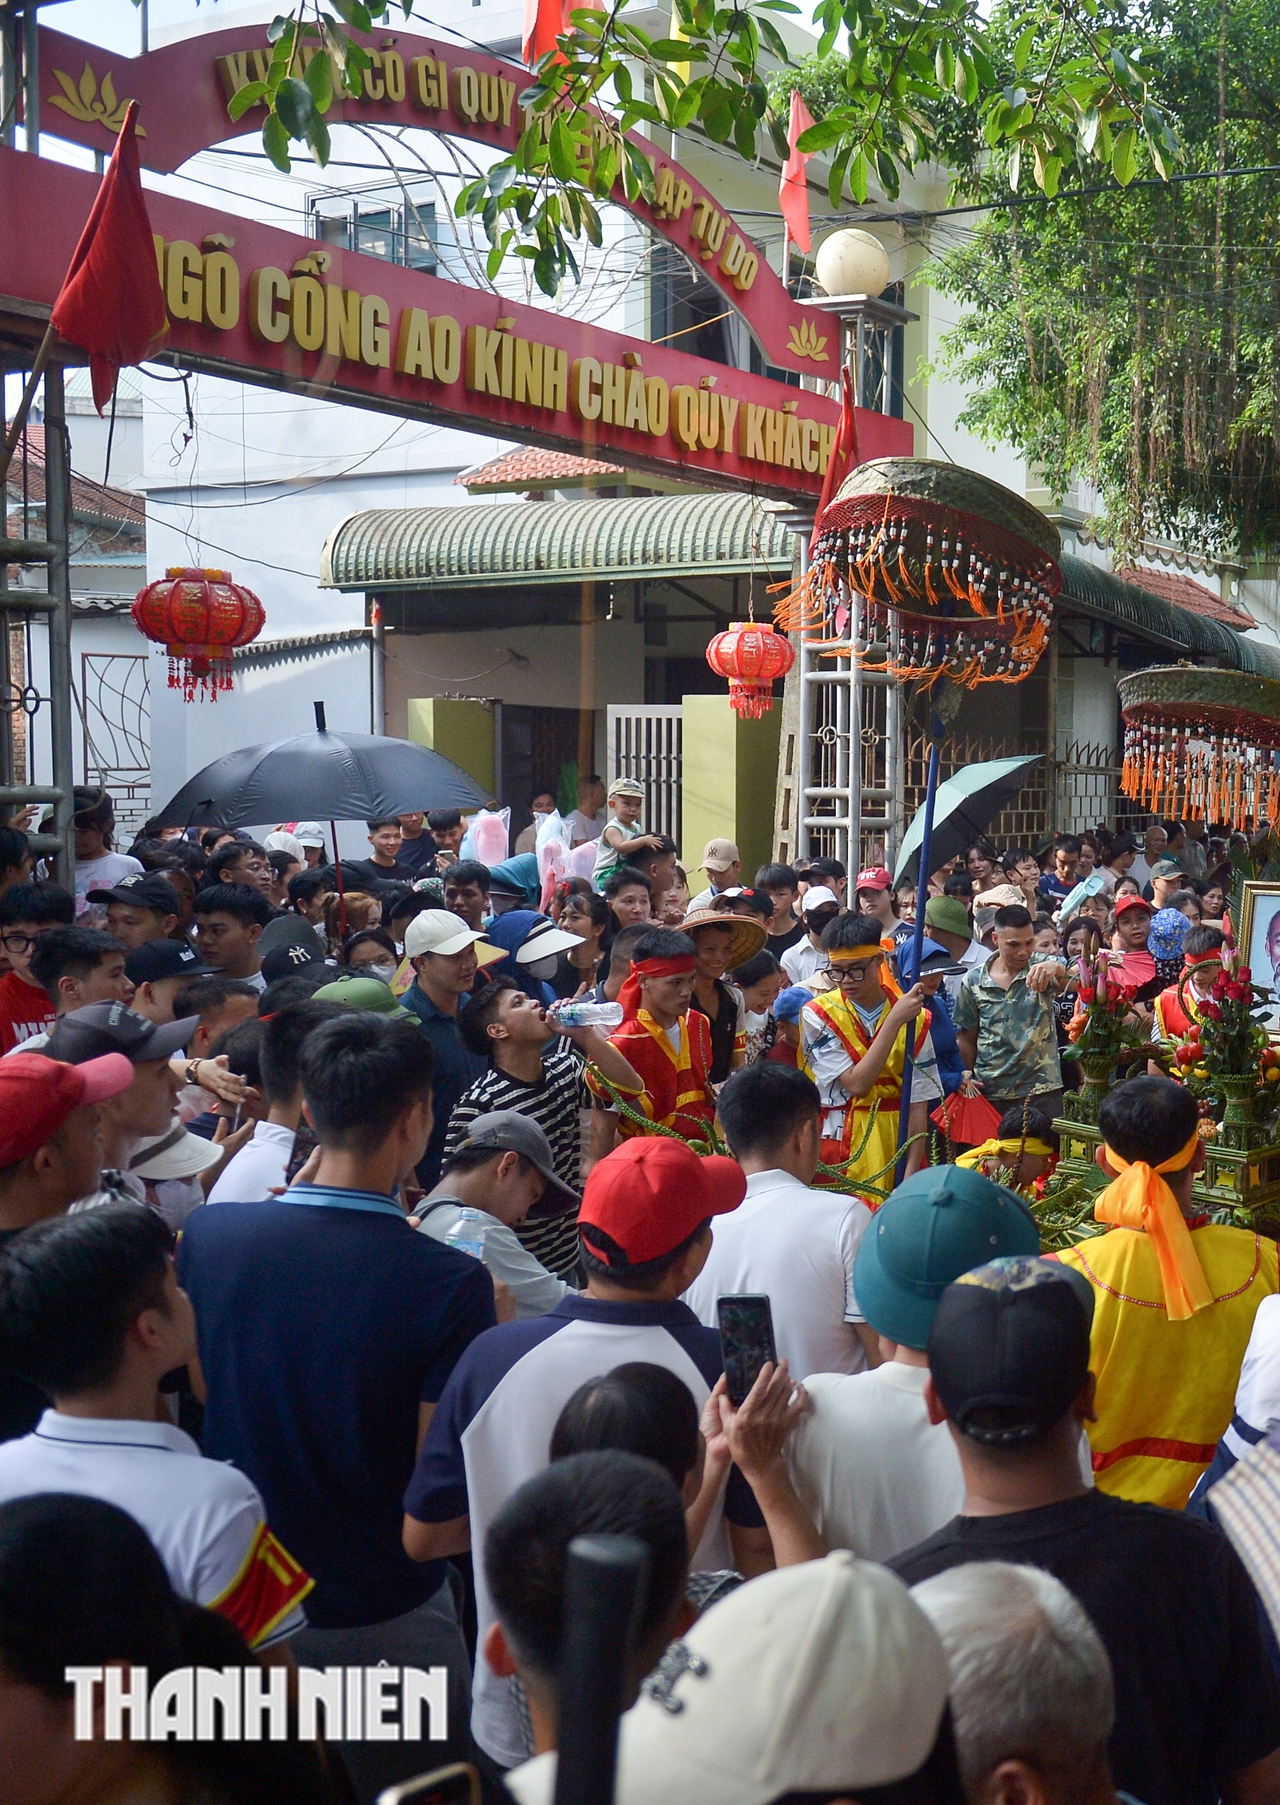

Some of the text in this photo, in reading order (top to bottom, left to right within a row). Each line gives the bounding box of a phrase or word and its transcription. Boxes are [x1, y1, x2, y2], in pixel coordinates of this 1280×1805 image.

[692, 196, 732, 261] TỰ
[720, 233, 759, 291] DO
[253, 250, 391, 369] CỔNG
[399, 307, 462, 385] AO
[468, 316, 568, 413] KÍNH
[574, 352, 670, 437] CHÀO
[743, 400, 839, 476] KHÁCH
